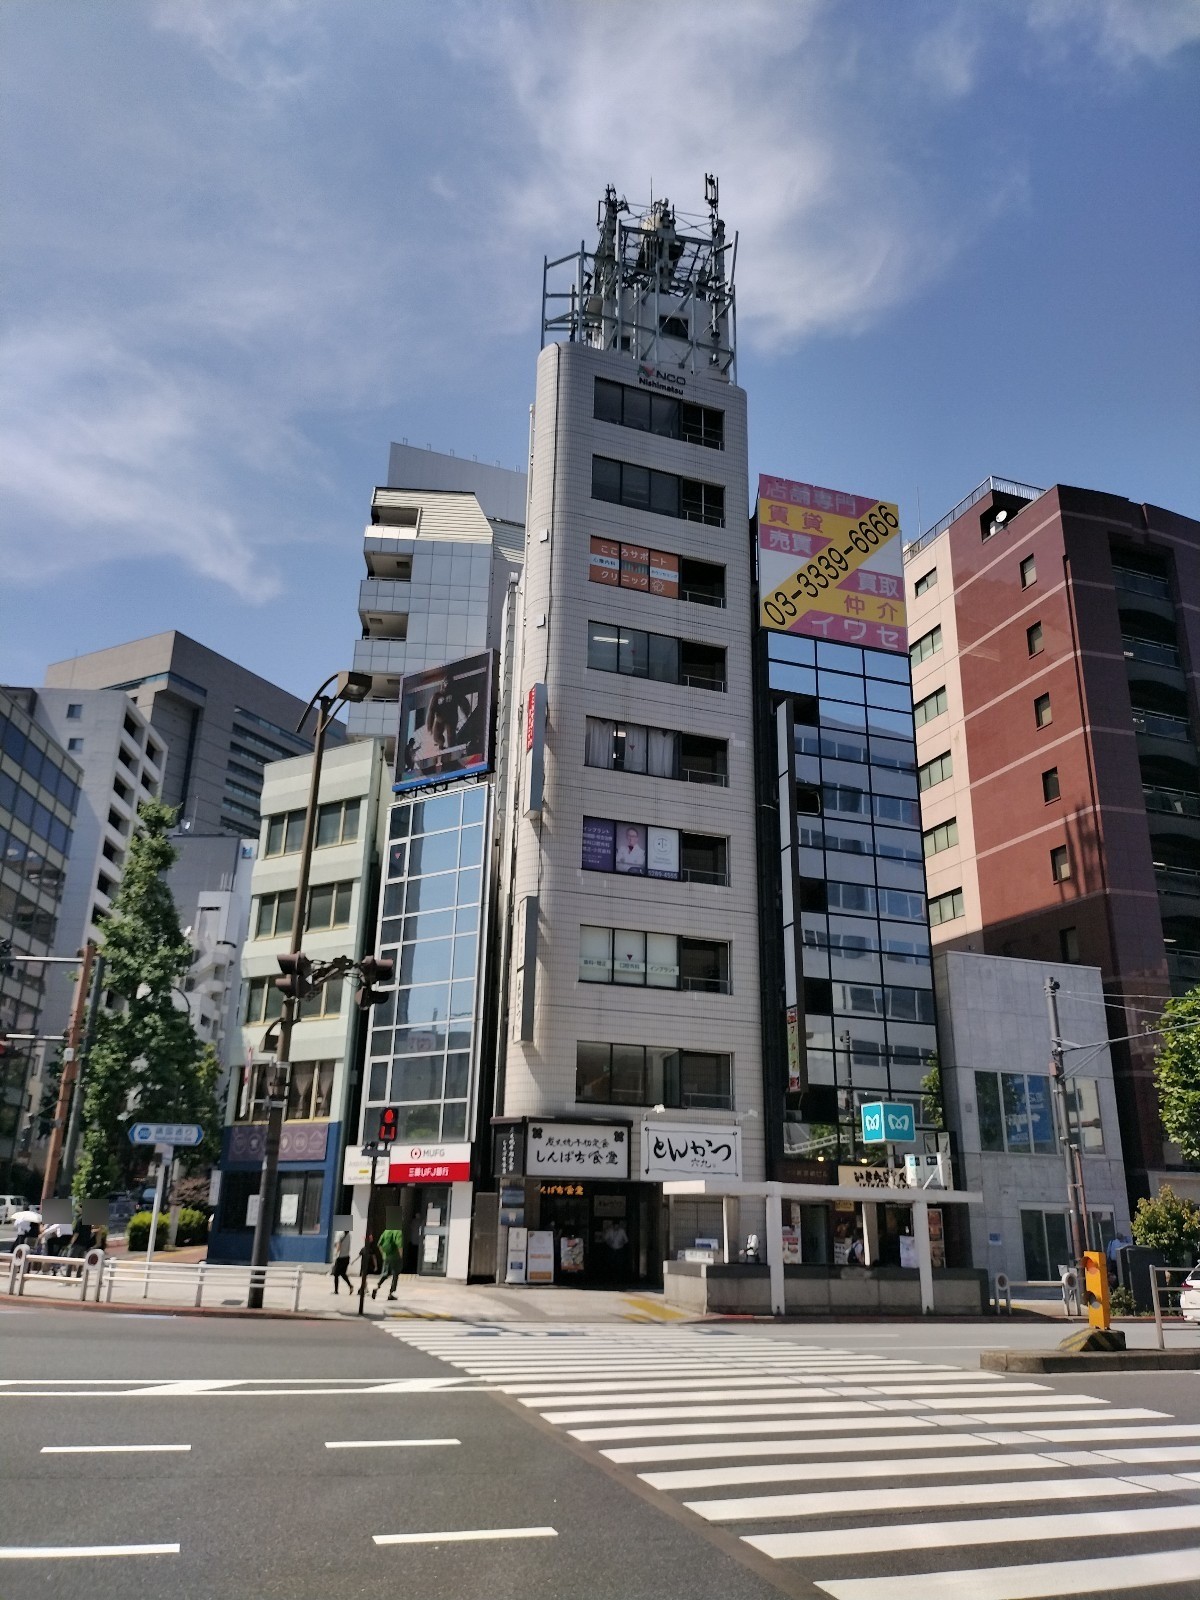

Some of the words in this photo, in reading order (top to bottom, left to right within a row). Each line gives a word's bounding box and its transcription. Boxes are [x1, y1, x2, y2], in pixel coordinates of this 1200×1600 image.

[638, 377, 684, 396] Nishimatsu
[601, 545, 667, 566] こころサポート
[769, 530, 812, 556] 売買
[764, 504, 899, 626] 03-3339-6666
[601, 571, 648, 586] クリニック
[858, 573, 899, 598] 買取
[843, 594, 898, 622] 仲介
[811, 616, 899, 649] イワセ
[423, 1149, 445, 1157] MUFG
[653, 1136, 732, 1162] とんかつ
[408, 1167, 449, 1177] 三菱UFJ銀行
